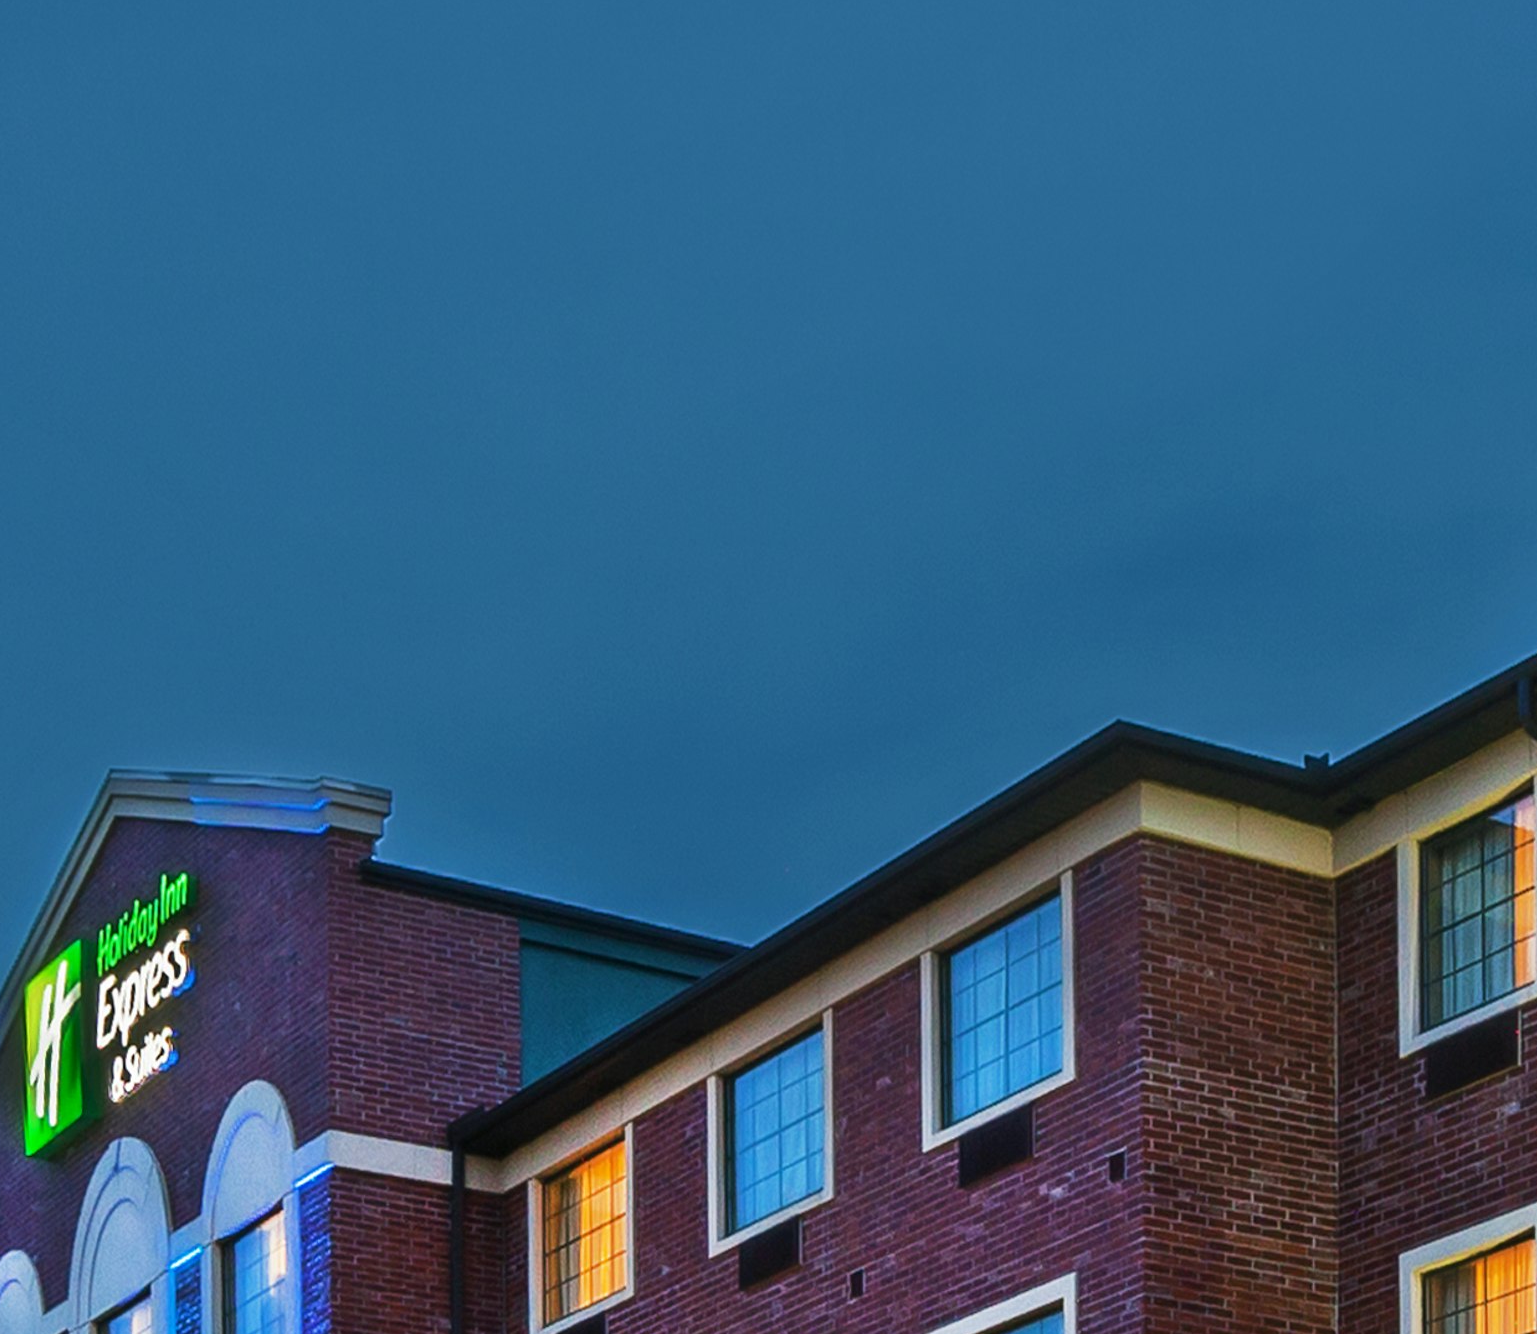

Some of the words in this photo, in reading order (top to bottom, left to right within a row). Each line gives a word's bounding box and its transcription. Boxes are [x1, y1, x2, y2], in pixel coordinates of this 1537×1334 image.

[96, 898, 159, 978] Holiday
[160, 872, 189, 925] Inn
[96, 929, 191, 1050] Express
[108, 1055, 125, 1104] &
[125, 1025, 175, 1093] Suites
